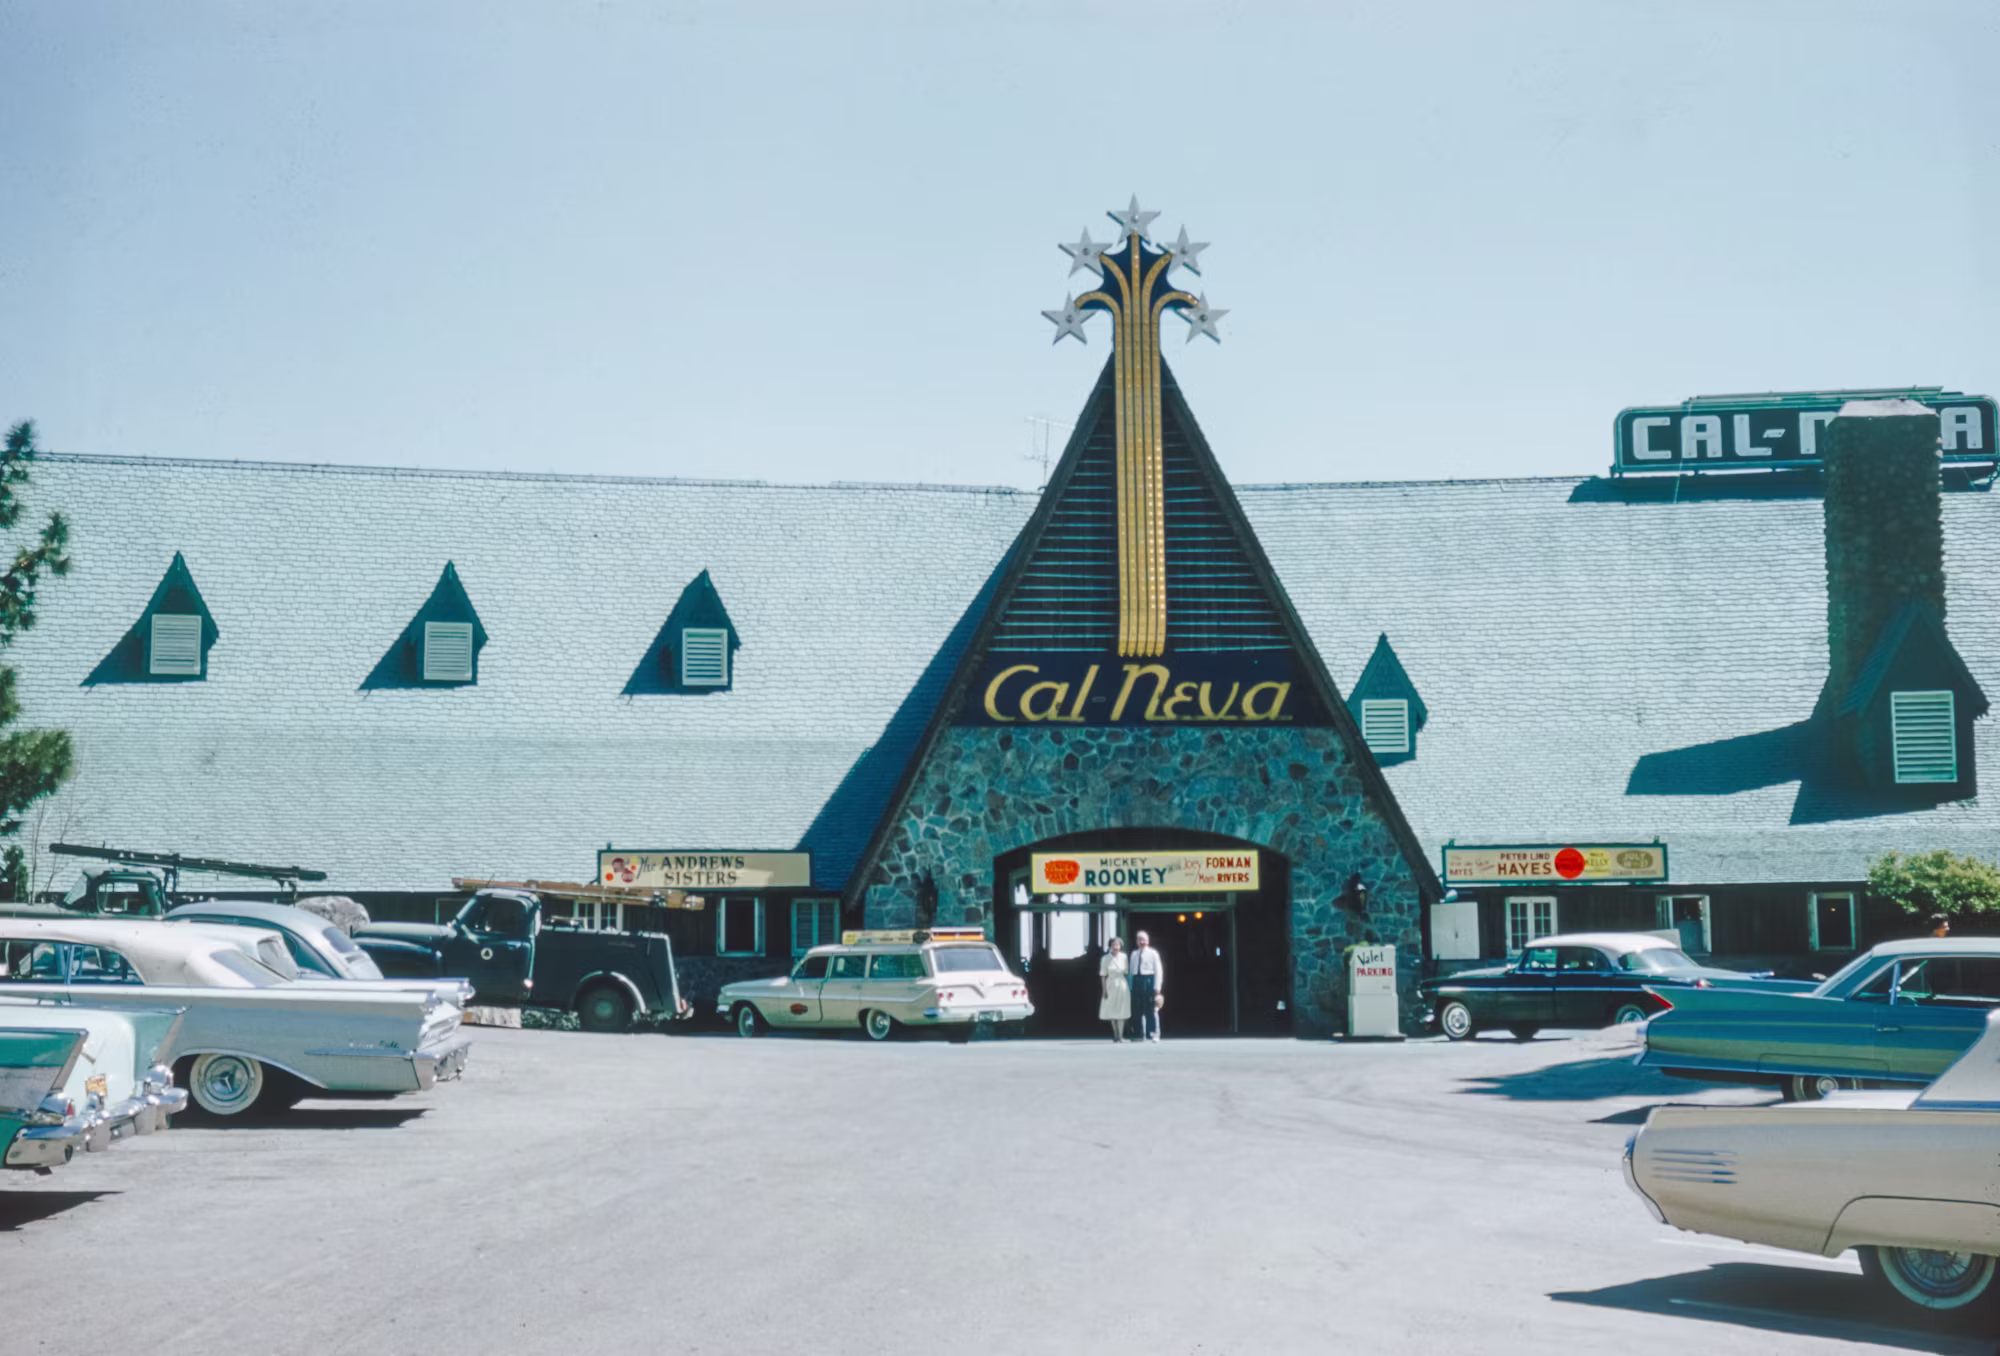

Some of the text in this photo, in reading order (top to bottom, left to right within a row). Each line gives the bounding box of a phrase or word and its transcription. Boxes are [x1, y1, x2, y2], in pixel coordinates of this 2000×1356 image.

[1632, 406, 1983, 459] CAL-NA
[1100, 857, 1147, 867] MICKEY
[1205, 857, 1251, 868] FORMAN
[1530, 852, 1550, 860] LIND
[660, 856, 745, 870] ANDREWS
[1498, 862, 1552, 875] HAYES
[664, 870, 737, 885] SISTERS
[1085, 868, 1167, 887] ROONEY
[1217, 872, 1249, 882] RIVERS
[1357, 949, 1385, 965] Valet
[1356, 967, 1393, 977] PARKING
